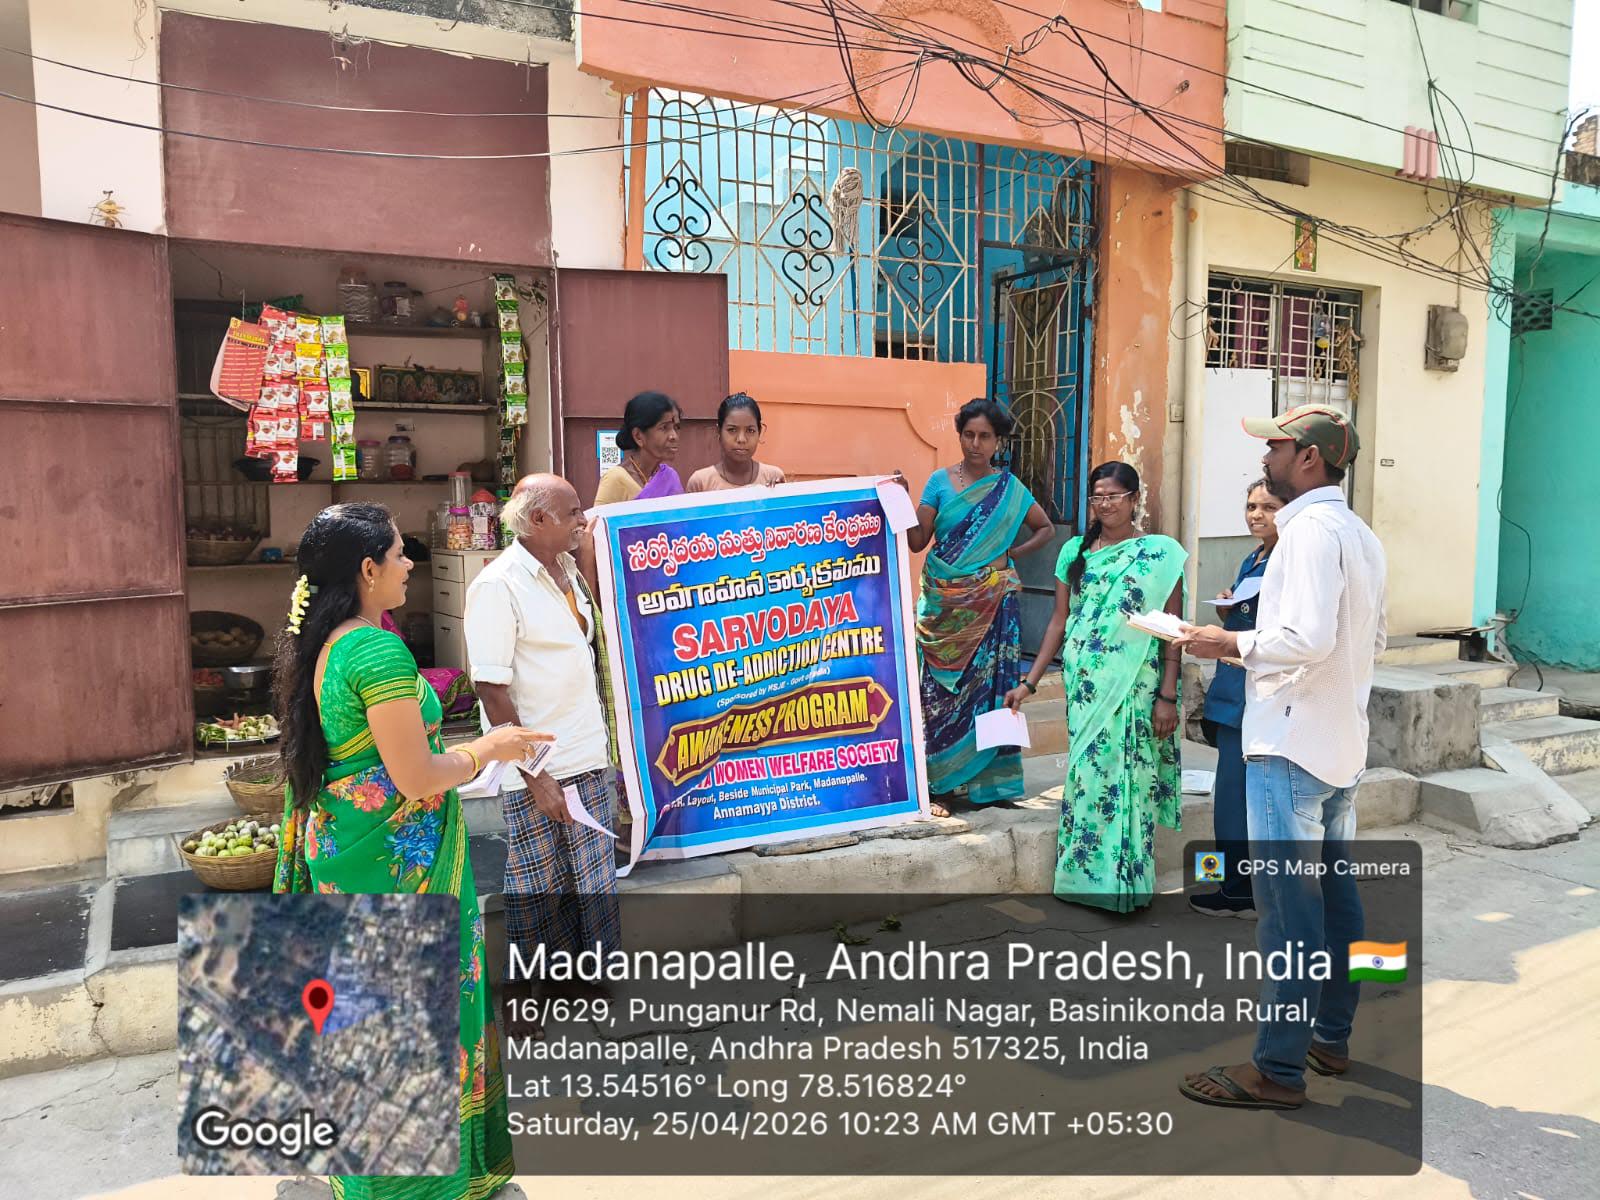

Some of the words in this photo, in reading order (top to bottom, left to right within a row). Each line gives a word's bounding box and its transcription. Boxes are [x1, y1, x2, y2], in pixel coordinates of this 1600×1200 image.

[628, 531, 717, 576] సర్వోదయ
[718, 527, 766, 563] మత్తు
[764, 521, 822, 552] నివారణ
[822, 511, 880, 547] కేంద్రము
[637, 571, 765, 615] అవగాహన
[768, 553, 880, 597] కార్యక్రమము
[673, 592, 858, 661] SARVODAYA
[654, 669, 711, 706] DRUG
[714, 637, 821, 690] DE-ADDICTION
[821, 626, 885, 662] CENTRE
[758, 686, 766, 695] by
[773, 688, 869, 738] PROGRAM
[713, 757, 768, 787] WOMEN
[768, 747, 838, 778] WELFARE
[838, 739, 899, 769] SOCIETY
[719, 788, 749, 801] Beside
[751, 781, 789, 799] Municipal
[790, 778, 813, 793] Park,
[813, 773, 868, 790] Madanapalle.
[713, 798, 778, 820] Annamayya
[779, 793, 820, 810] District.
